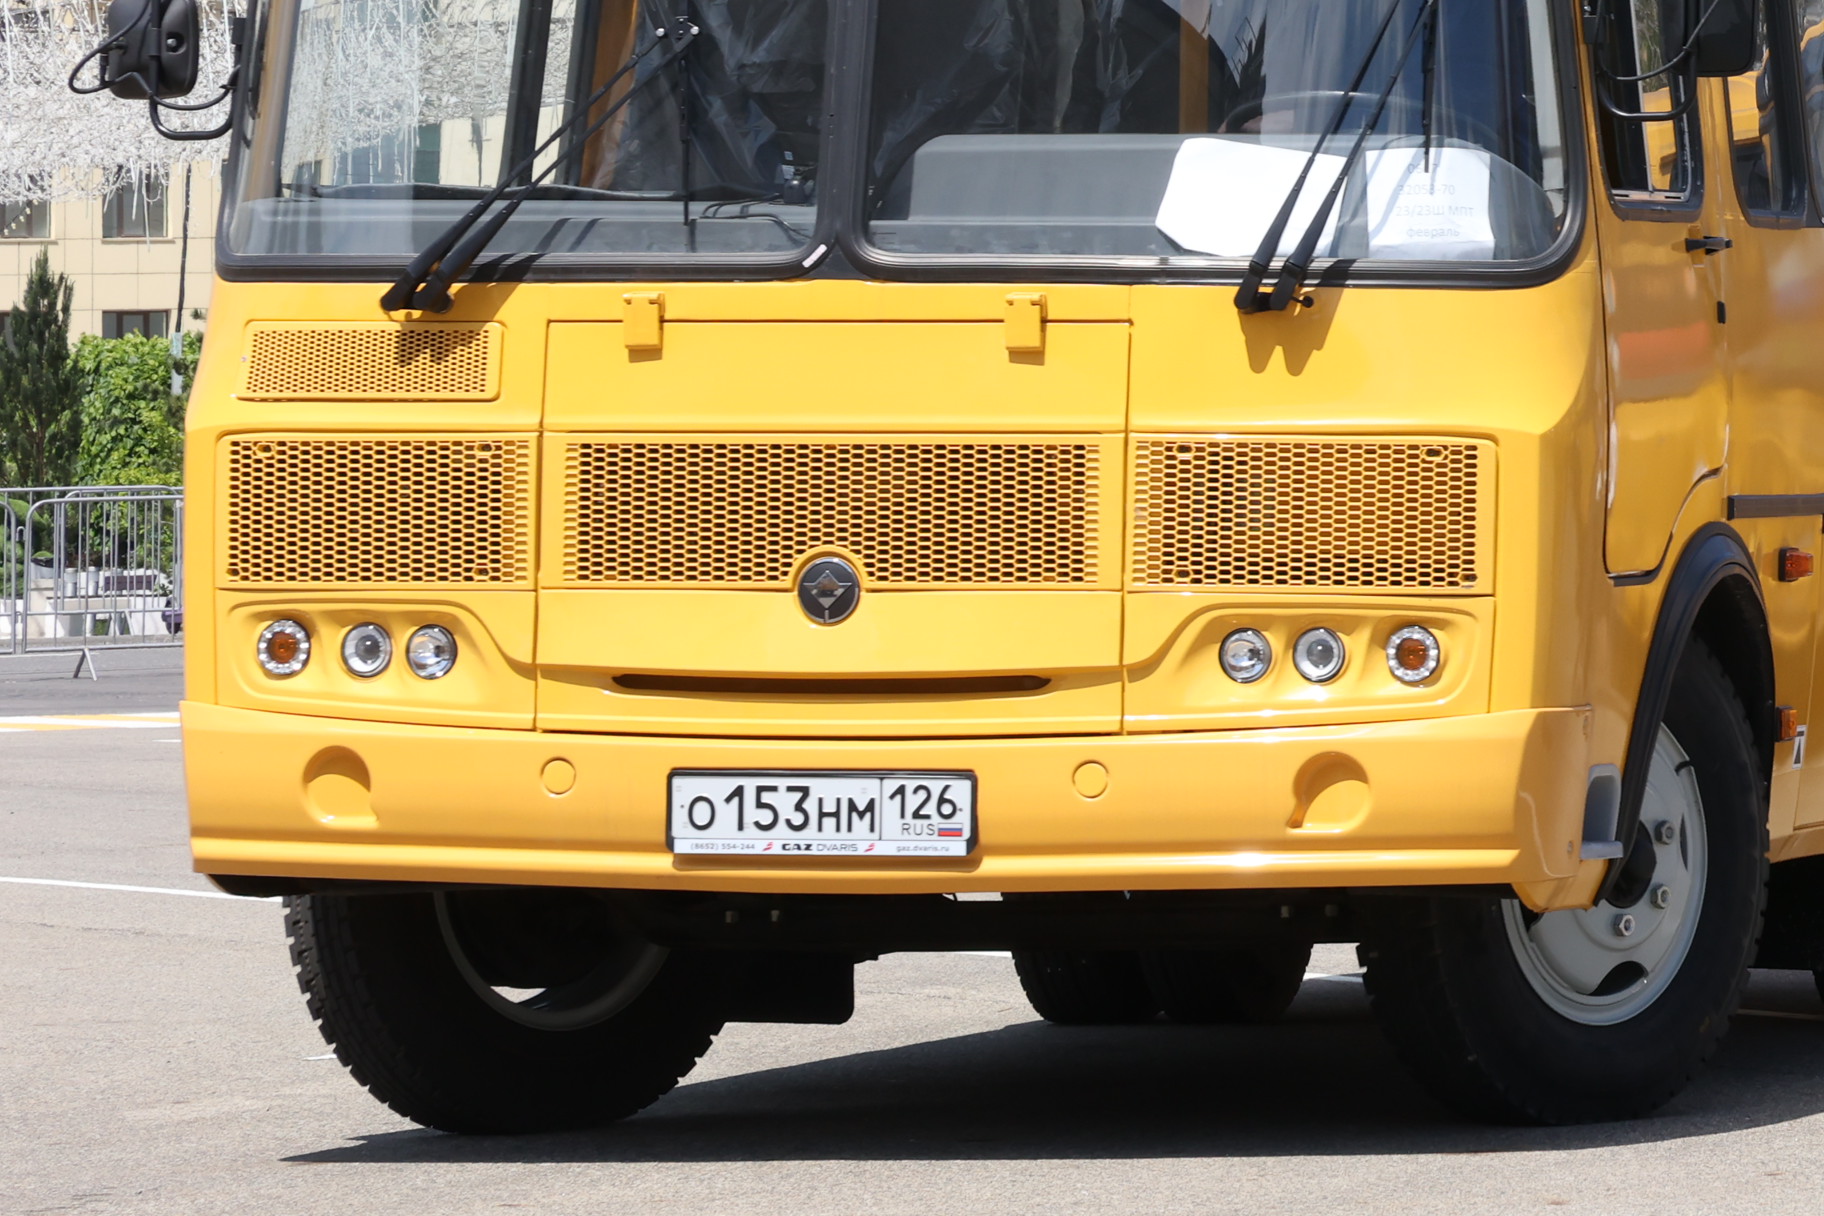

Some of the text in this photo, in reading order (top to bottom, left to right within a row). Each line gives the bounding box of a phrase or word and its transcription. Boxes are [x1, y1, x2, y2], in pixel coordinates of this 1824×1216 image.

[888, 783, 958, 820] 126
[901, 823, 936, 836] RUS
[781, 843, 813, 852] GAZ
[816, 843, 858, 852] DVARIS
